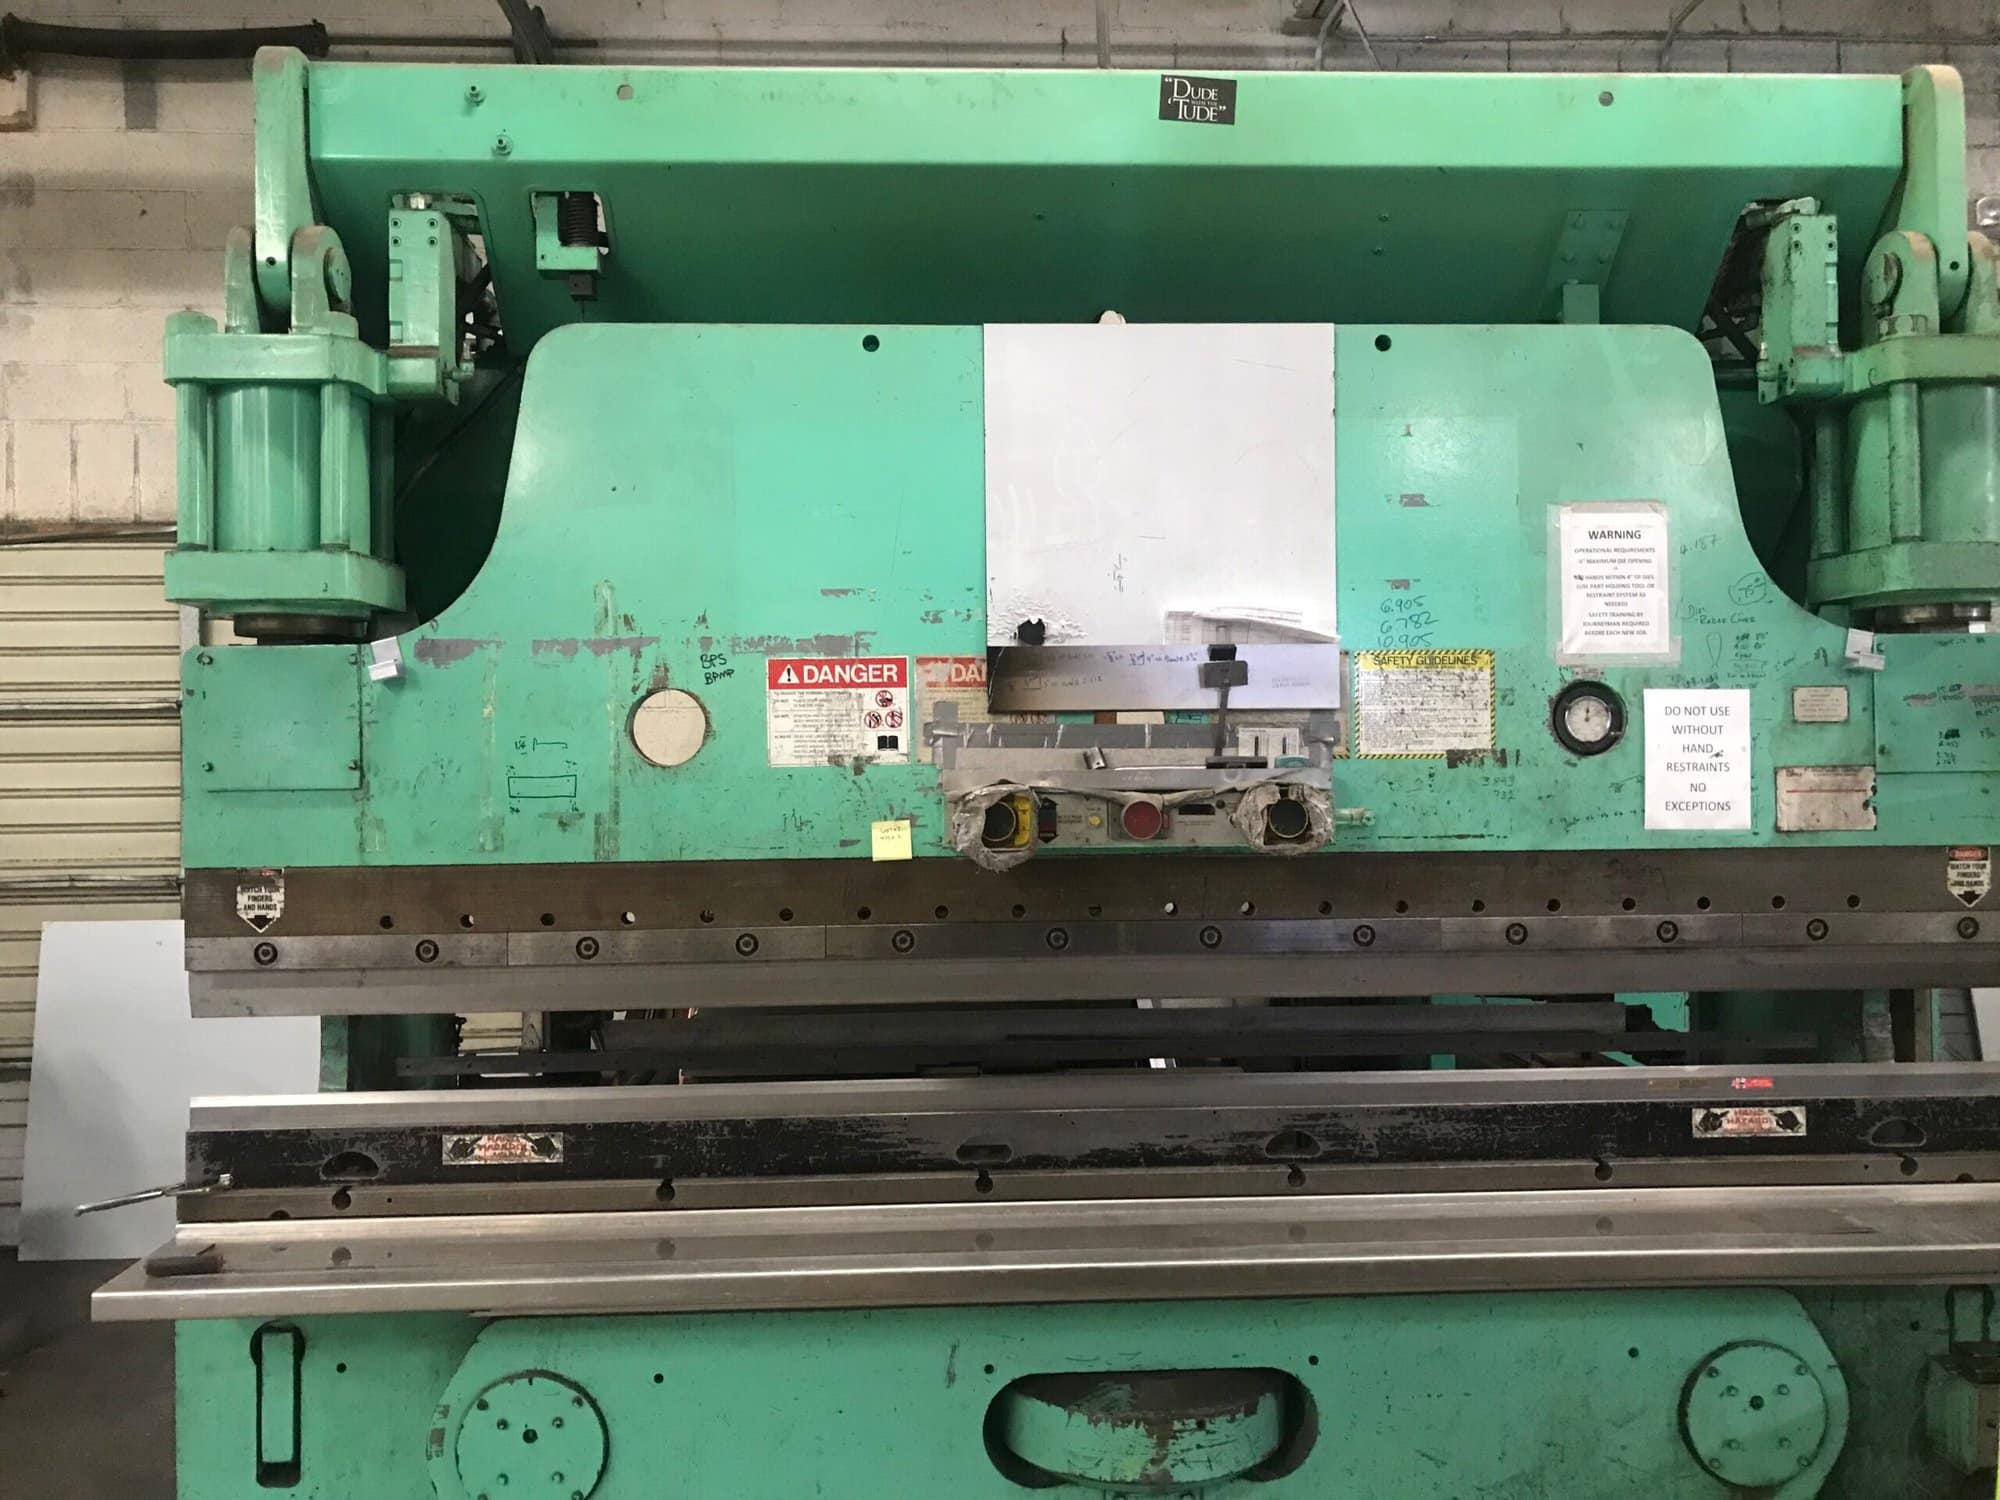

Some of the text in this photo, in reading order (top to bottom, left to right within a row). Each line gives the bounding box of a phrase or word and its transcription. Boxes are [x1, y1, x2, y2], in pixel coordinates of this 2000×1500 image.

[1588, 529, 1642, 540] WARNING
[1380, 595, 1426, 614] 6.905
[700, 653, 728, 670] BPS
[1373, 655, 1479, 667] SAFETY GUIDELINES
[803, 664, 899, 684] DANGER
[1664, 705, 1731, 717] DO NOT USE
[1671, 724, 1724, 735] WITHOUT
[1682, 743, 1714, 754] HAND
[1666, 761, 1731, 773] RESTRAINTS
[1689, 782, 1707, 793] NO
[1665, 801, 1732, 812] EXCEPTIONS
[247, 894, 273, 902] FINGERS
[243, 903, 278, 911] AND HANDS
